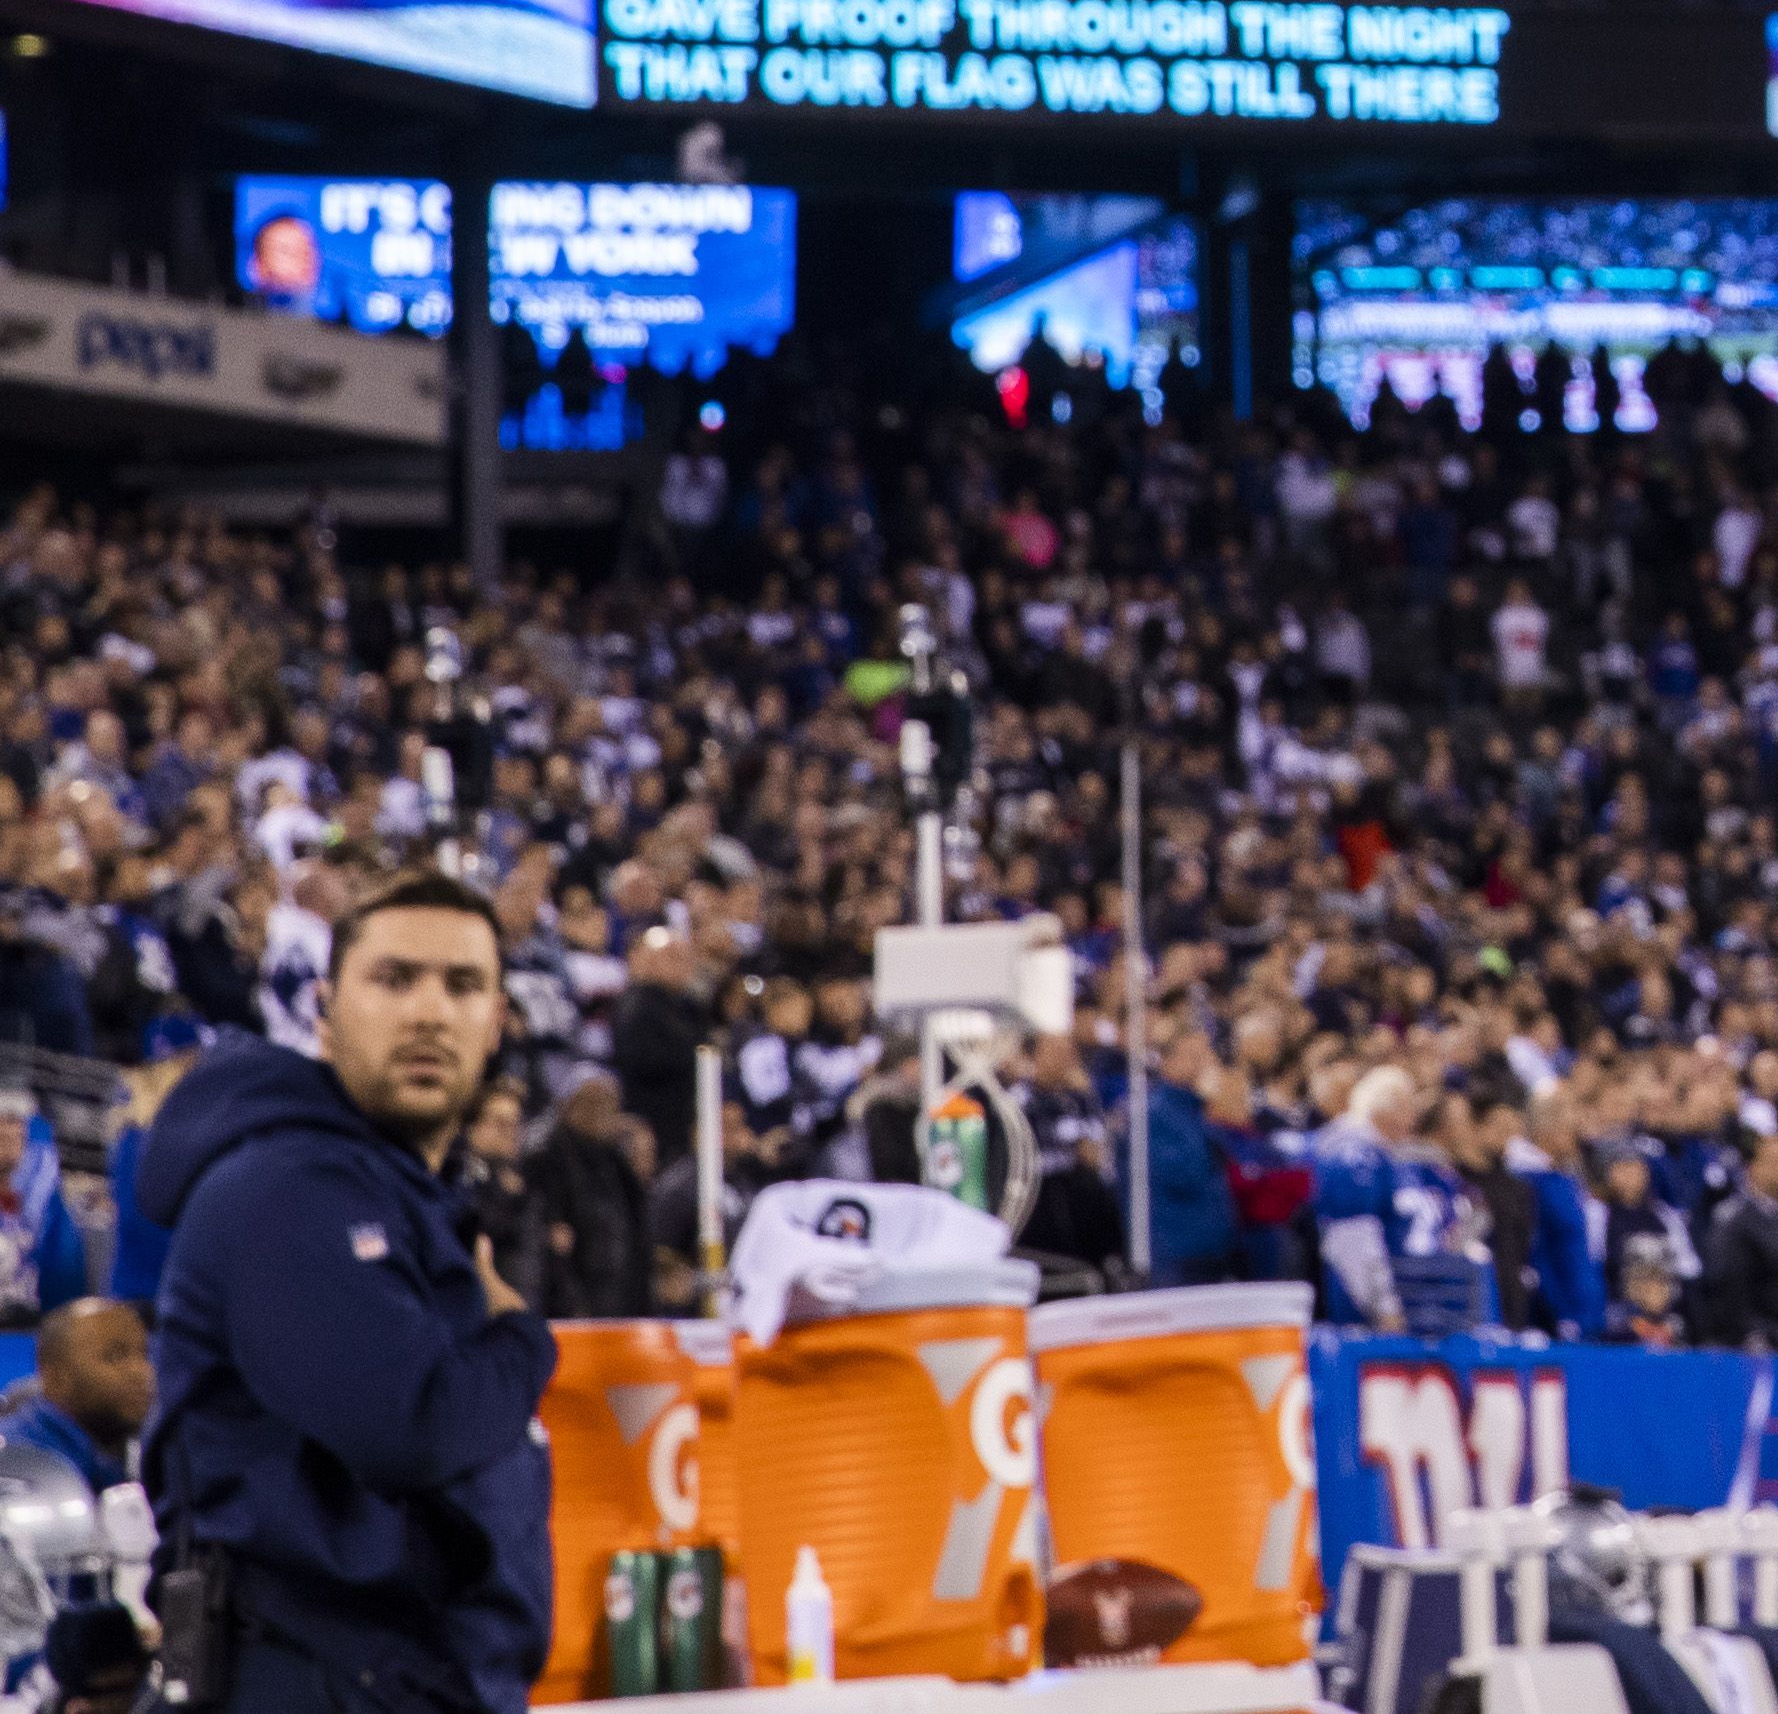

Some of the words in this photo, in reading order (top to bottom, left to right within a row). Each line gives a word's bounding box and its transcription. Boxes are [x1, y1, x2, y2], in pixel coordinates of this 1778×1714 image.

[1229, 0, 1345, 60] THE
[1347, 5, 1510, 64] NIGHT
[604, 40, 758, 103] THAT
[759, 45, 888, 106] OUR
[891, 51, 1037, 111] FLAG
[1037, 54, 1164, 115] WAS
[1167, 59, 1316, 119] STILL
[1316, 63, 1499, 124] THERE
[968, 1356, 1038, 1489] G
